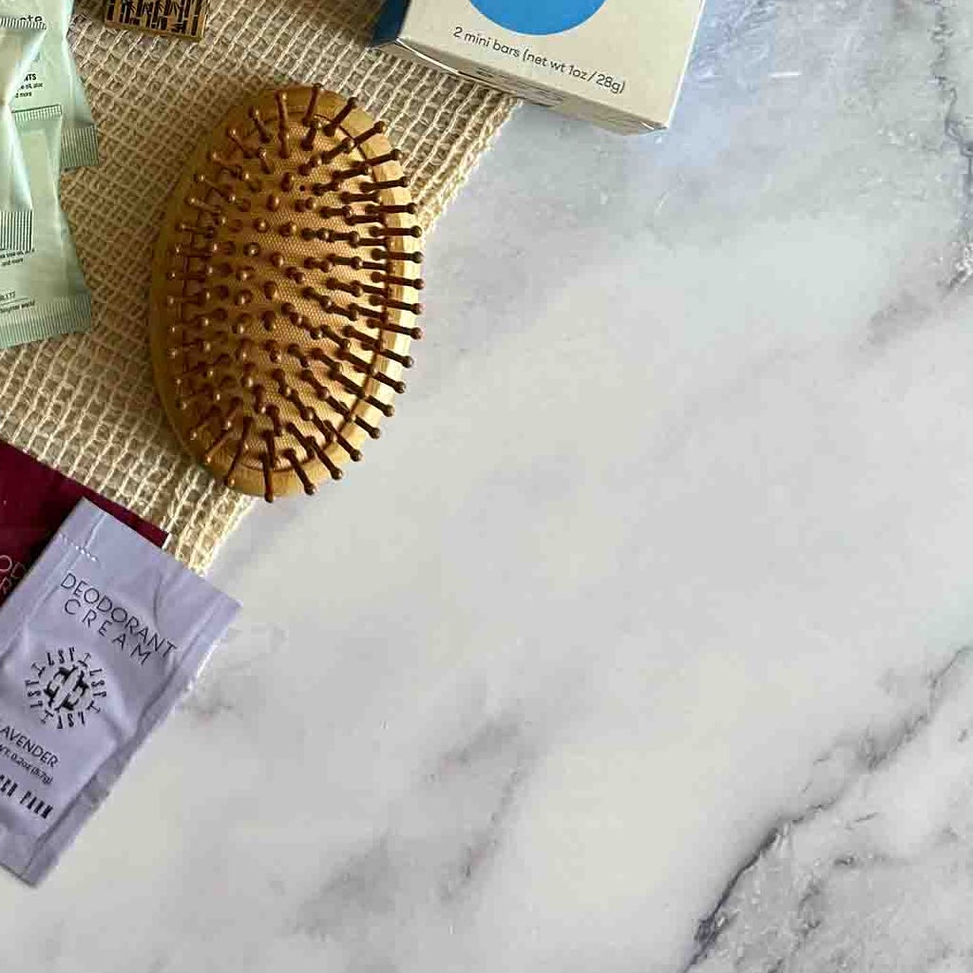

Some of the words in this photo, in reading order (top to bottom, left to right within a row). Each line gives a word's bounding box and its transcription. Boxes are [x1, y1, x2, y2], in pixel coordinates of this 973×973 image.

[453, 26, 464, 38] 2
[463, 32, 492, 48] mini
[492, 38, 520, 57] bars
[522, 48, 548, 67] (net
[550, 60, 566, 73] wt
[60, 572, 178, 658] DEODORANT
[64, 598, 152, 666] CREAM
